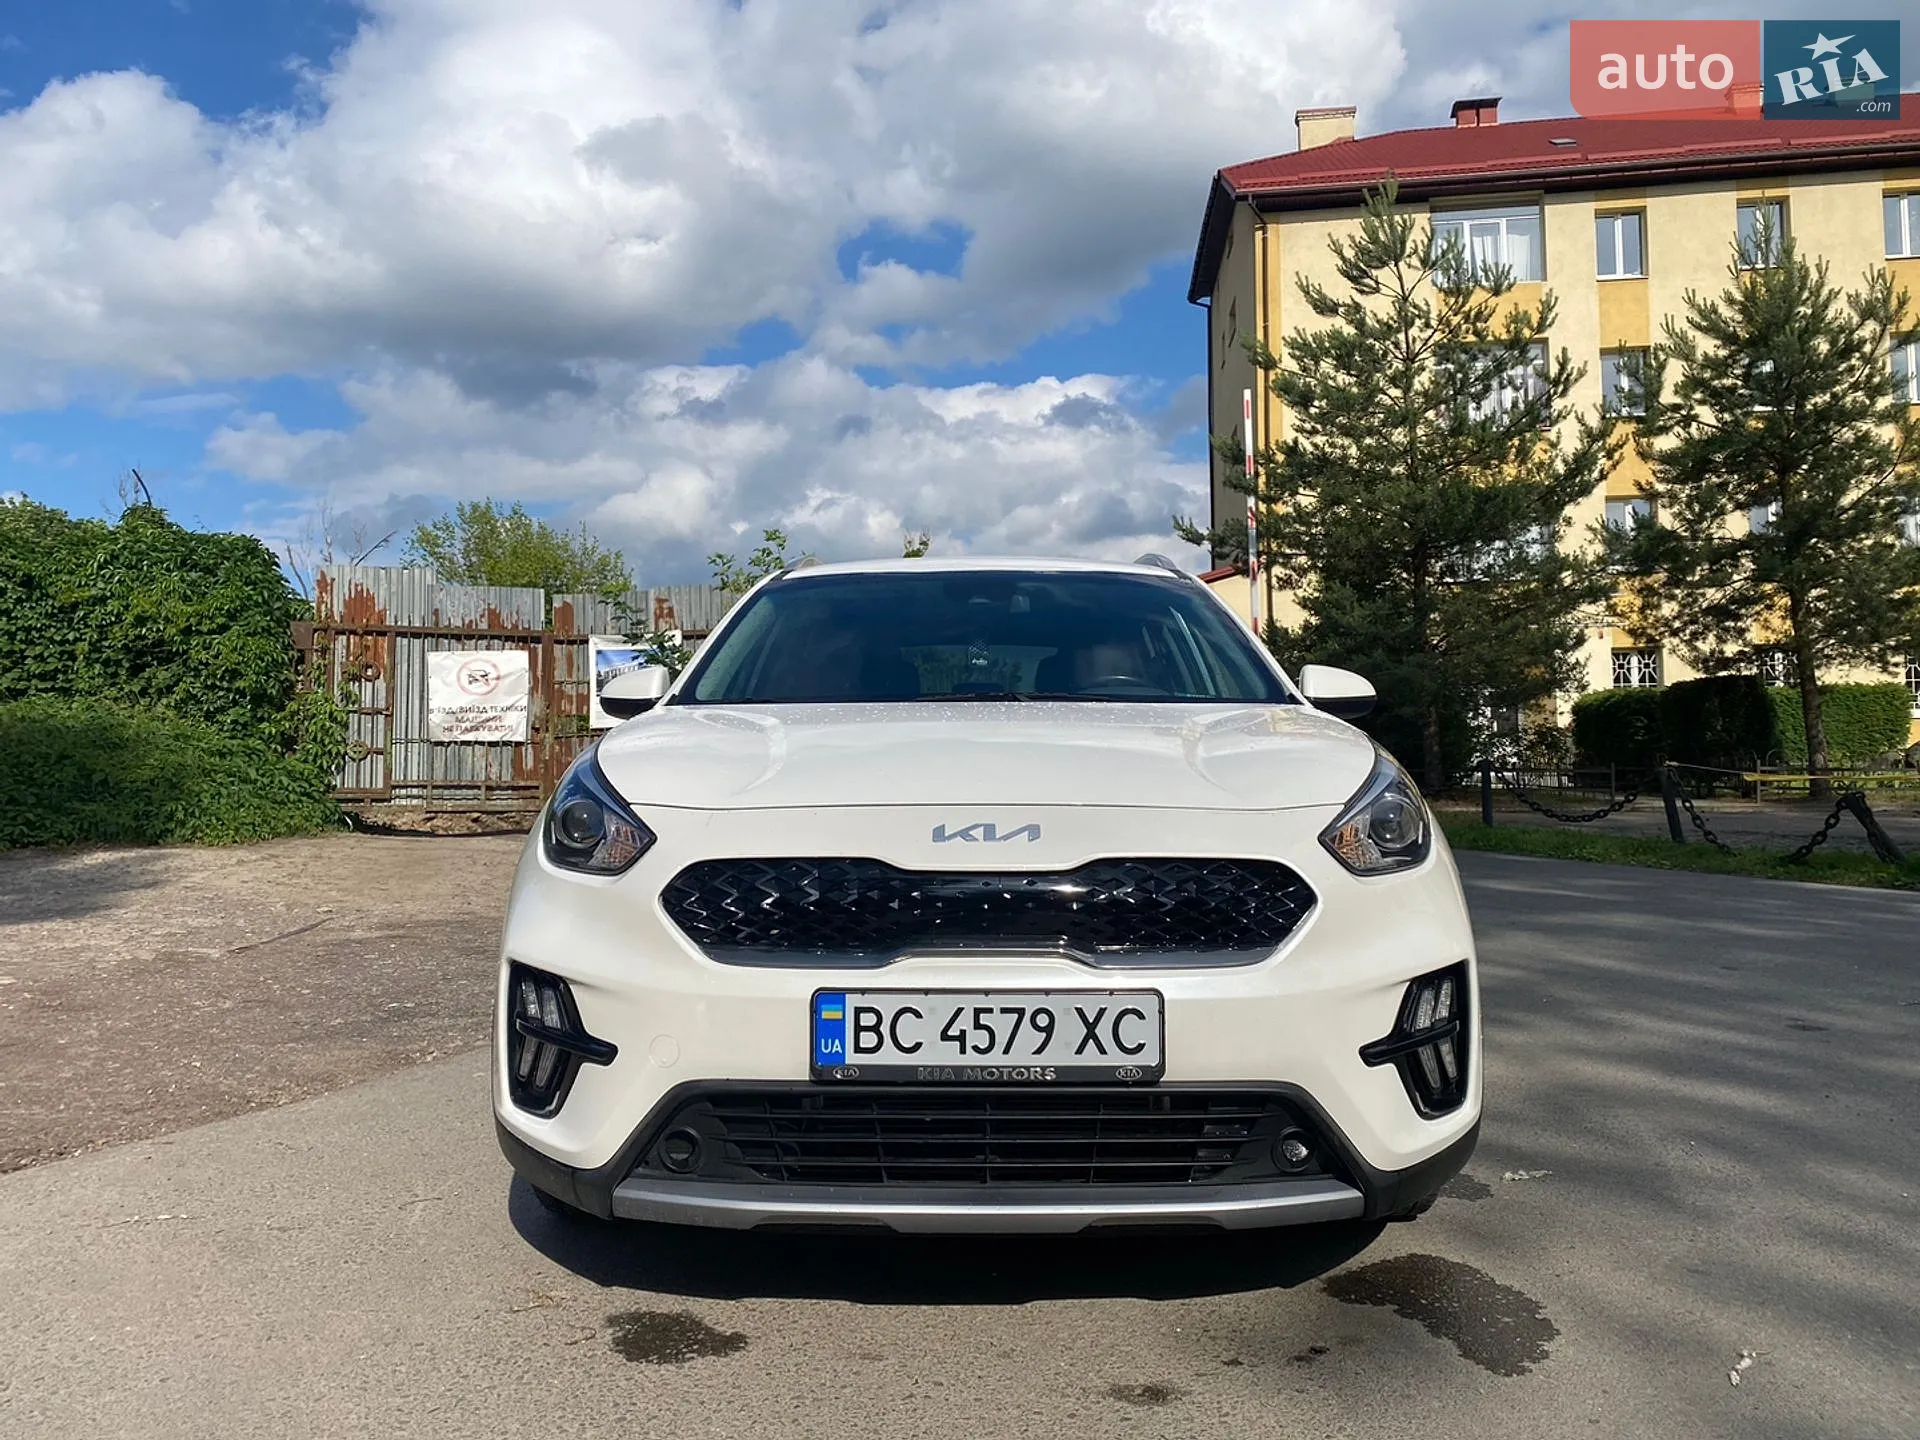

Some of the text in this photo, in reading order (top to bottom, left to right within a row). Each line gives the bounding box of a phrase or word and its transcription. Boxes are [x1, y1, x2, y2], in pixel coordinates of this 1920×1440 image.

[932, 823, 1041, 843] KIA
[852, 1006, 1147, 1055] BC 4579 XC
[821, 1039, 842, 1054] UA
[917, 1067, 1057, 1080] KIA MOTORS
